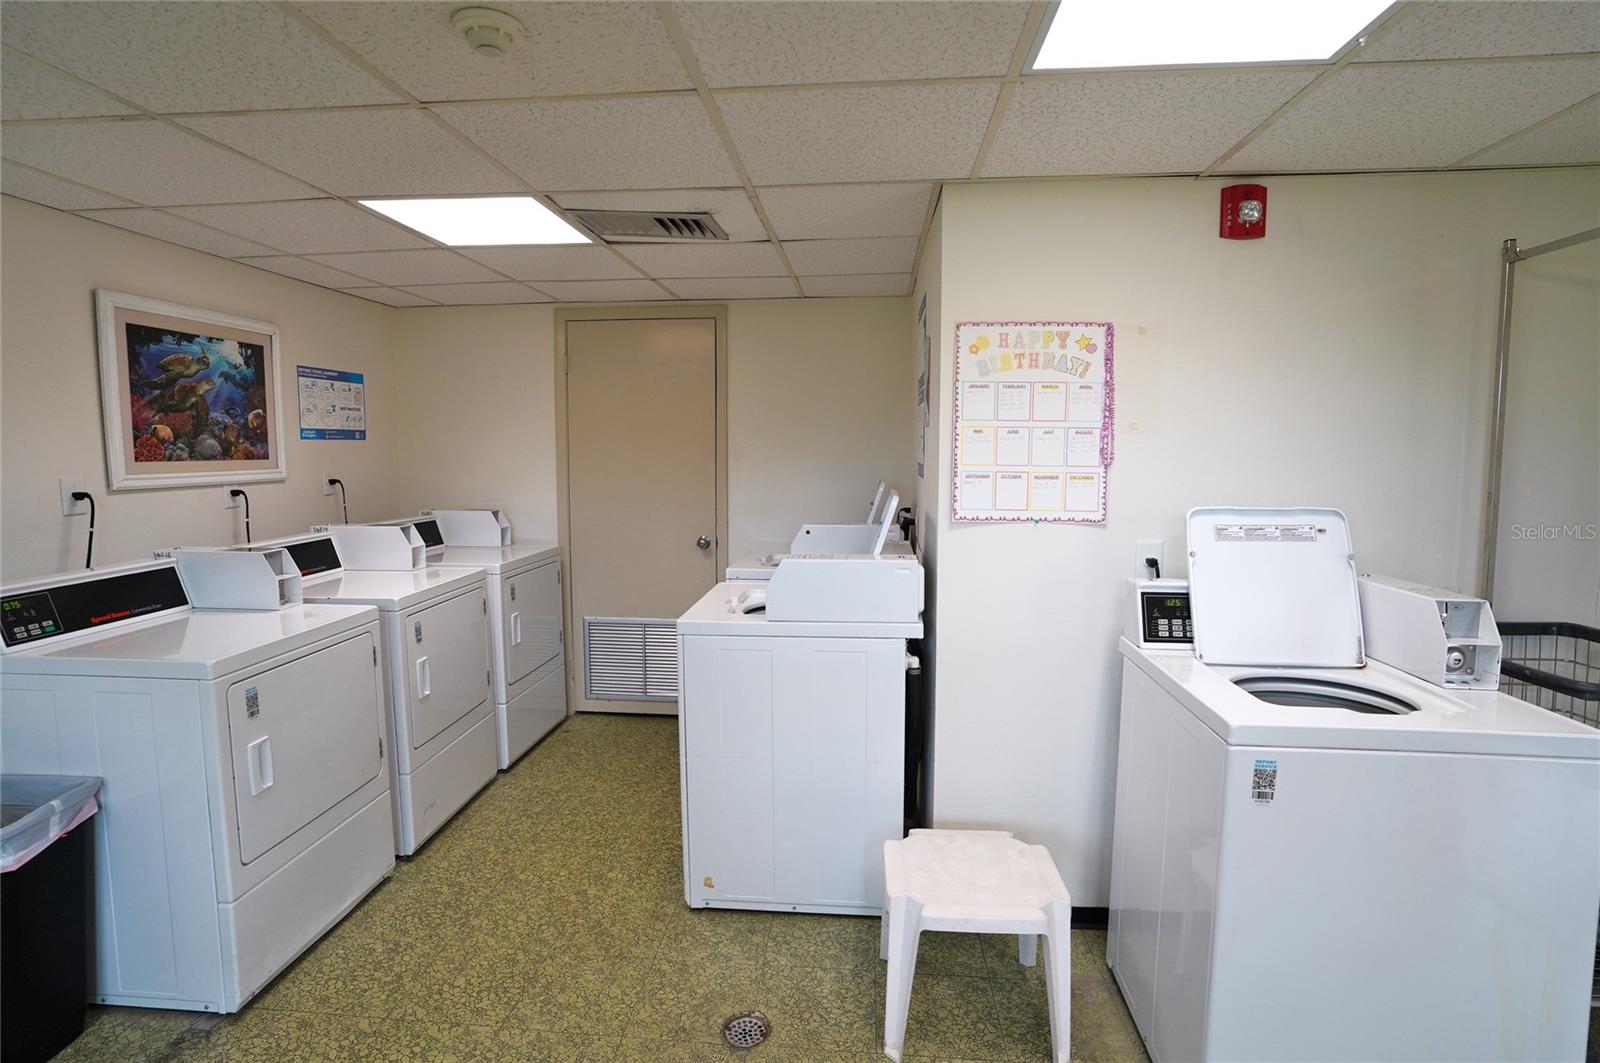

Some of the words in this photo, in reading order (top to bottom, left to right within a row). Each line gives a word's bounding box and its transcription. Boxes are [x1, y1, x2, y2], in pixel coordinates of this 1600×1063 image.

[997, 330, 1071, 350] HAPPY
[976, 351, 1093, 379] BIRTHDAY!
[90, 613, 112, 624] Speed
